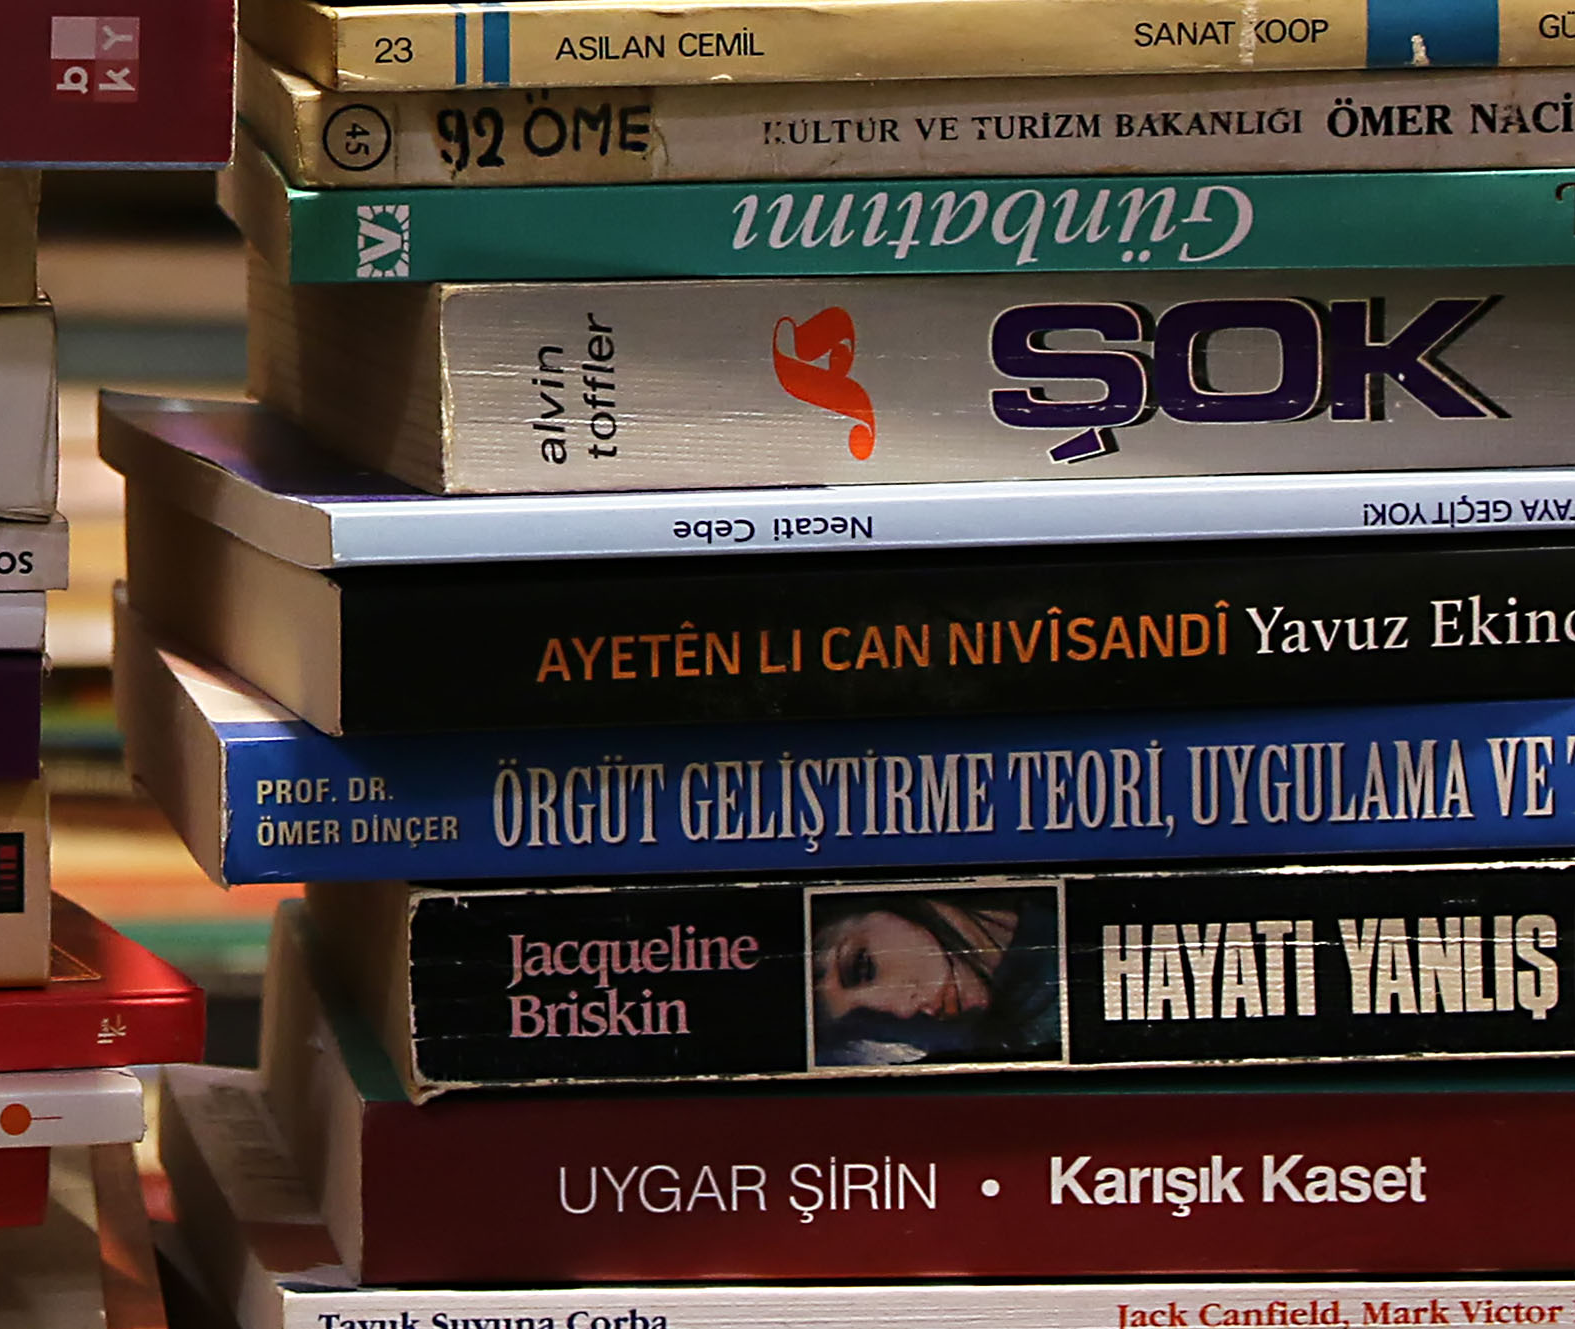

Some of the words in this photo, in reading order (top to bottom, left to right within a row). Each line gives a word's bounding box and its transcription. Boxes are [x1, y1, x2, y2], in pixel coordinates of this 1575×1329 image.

[374, 37, 413, 65] 23
[555, 33, 666, 61] ASILAN
[678, 26, 764, 58] CEMİL
[1134, 20, 1236, 48] SANAT
[436, 108, 505, 171] 92
[916, 116, 958, 141] VE
[972, 109, 1100, 140] TURİZM
[1115, 107, 1301, 137] BAKANLIĞI
[1327, 98, 1452, 138] ÖMER
[1470, 92, 1575, 135] NACİ
[731, 184, 1253, 265] Günbatımı
[582, 312, 617, 459] toffler
[990, 292, 1512, 464] ŞOK
[532, 344, 567, 464] alvin
[673, 517, 755, 543] Cebe
[772, 514, 873, 542] Necati
[1363, 502, 1427, 526] YOK!
[1431, 495, 1512, 528] GEÇİT
[536, 620, 740, 684] AYETÊN
[760, 629, 801, 673] LI
[821, 624, 931, 670] CAN
[1246, 605, 1409, 656] Yavuz
[256, 779, 336, 806] PROF.
[348, 777, 395, 804] DR.
[492, 756, 666, 848] ÖRGÜT
[679, 742, 994, 853] GELİŞTİRME
[1187, 738, 1474, 825] UYGULAMA
[1485, 735, 1553, 819] VE
[257, 814, 342, 848] ÖMER
[351, 812, 459, 849] DİNÇER
[507, 925, 759, 989] Jacqueline
[1102, 919, 1315, 1021] HAYATI
[1338, 914, 1559, 1020] YANLIŞ
[508, 989, 690, 1039] Briskin
[558, 1165, 766, 1215] UYGAR
[788, 1156, 936, 1223] ŞİRİN
[1050, 1155, 1244, 1216] Karışık
[1262, 1155, 1427, 1204] Kaset
[1117, 1302, 1188, 1329] Jack
[1362, 1299, 1449, 1325] Mark
[1459, 1299, 1564, 1324] Victor
